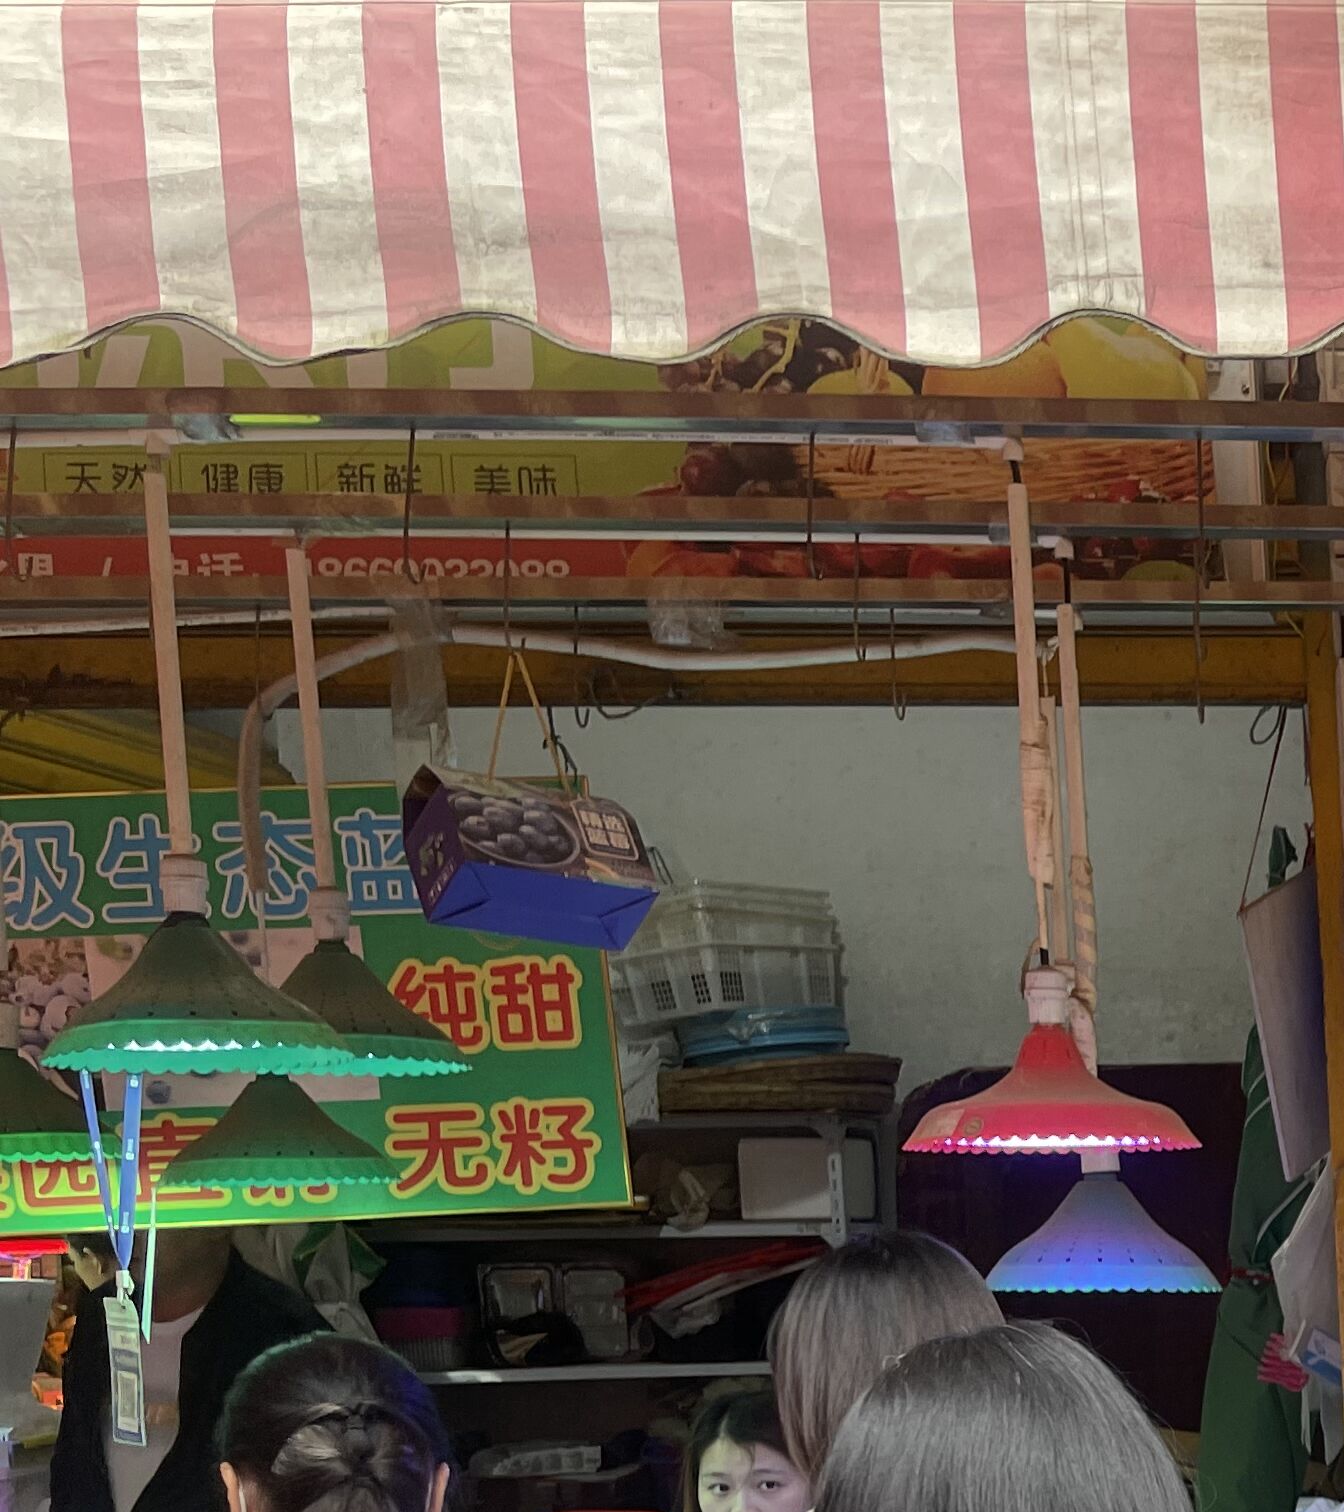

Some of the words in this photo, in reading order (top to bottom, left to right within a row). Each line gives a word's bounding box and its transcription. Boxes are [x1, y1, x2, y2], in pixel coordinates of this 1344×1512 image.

[65, 461, 147, 494] 天然
[201, 462, 285, 494] 健康
[336, 462, 423, 494] 新鲜
[473, 463, 558, 496] 美味
[389, 956, 580, 1051] 纯甜
[387, 1100, 599, 1194] 无籽
